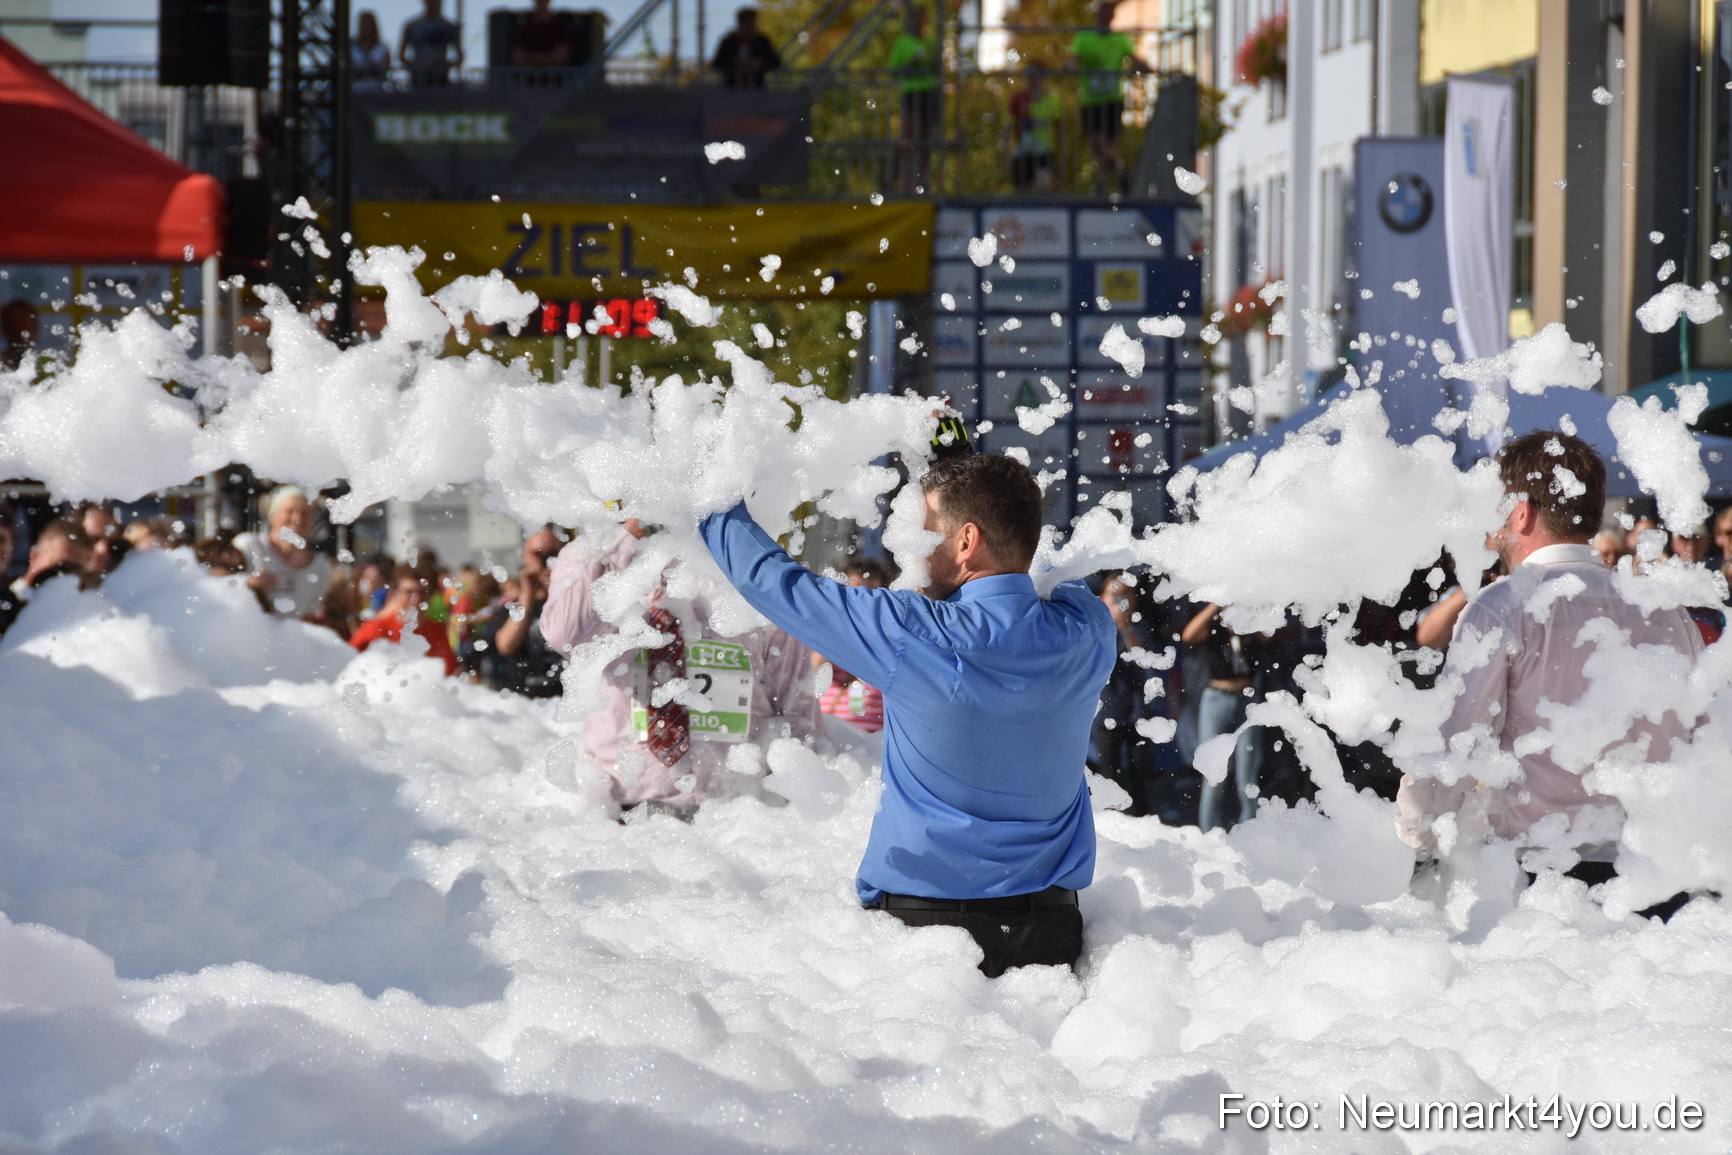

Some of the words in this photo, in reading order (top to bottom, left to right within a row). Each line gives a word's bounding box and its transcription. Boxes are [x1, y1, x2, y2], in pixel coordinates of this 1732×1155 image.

[373, 112, 511, 142] BOCK
[503, 222, 660, 278] ZIEL
[689, 714, 720, 728] RIO
